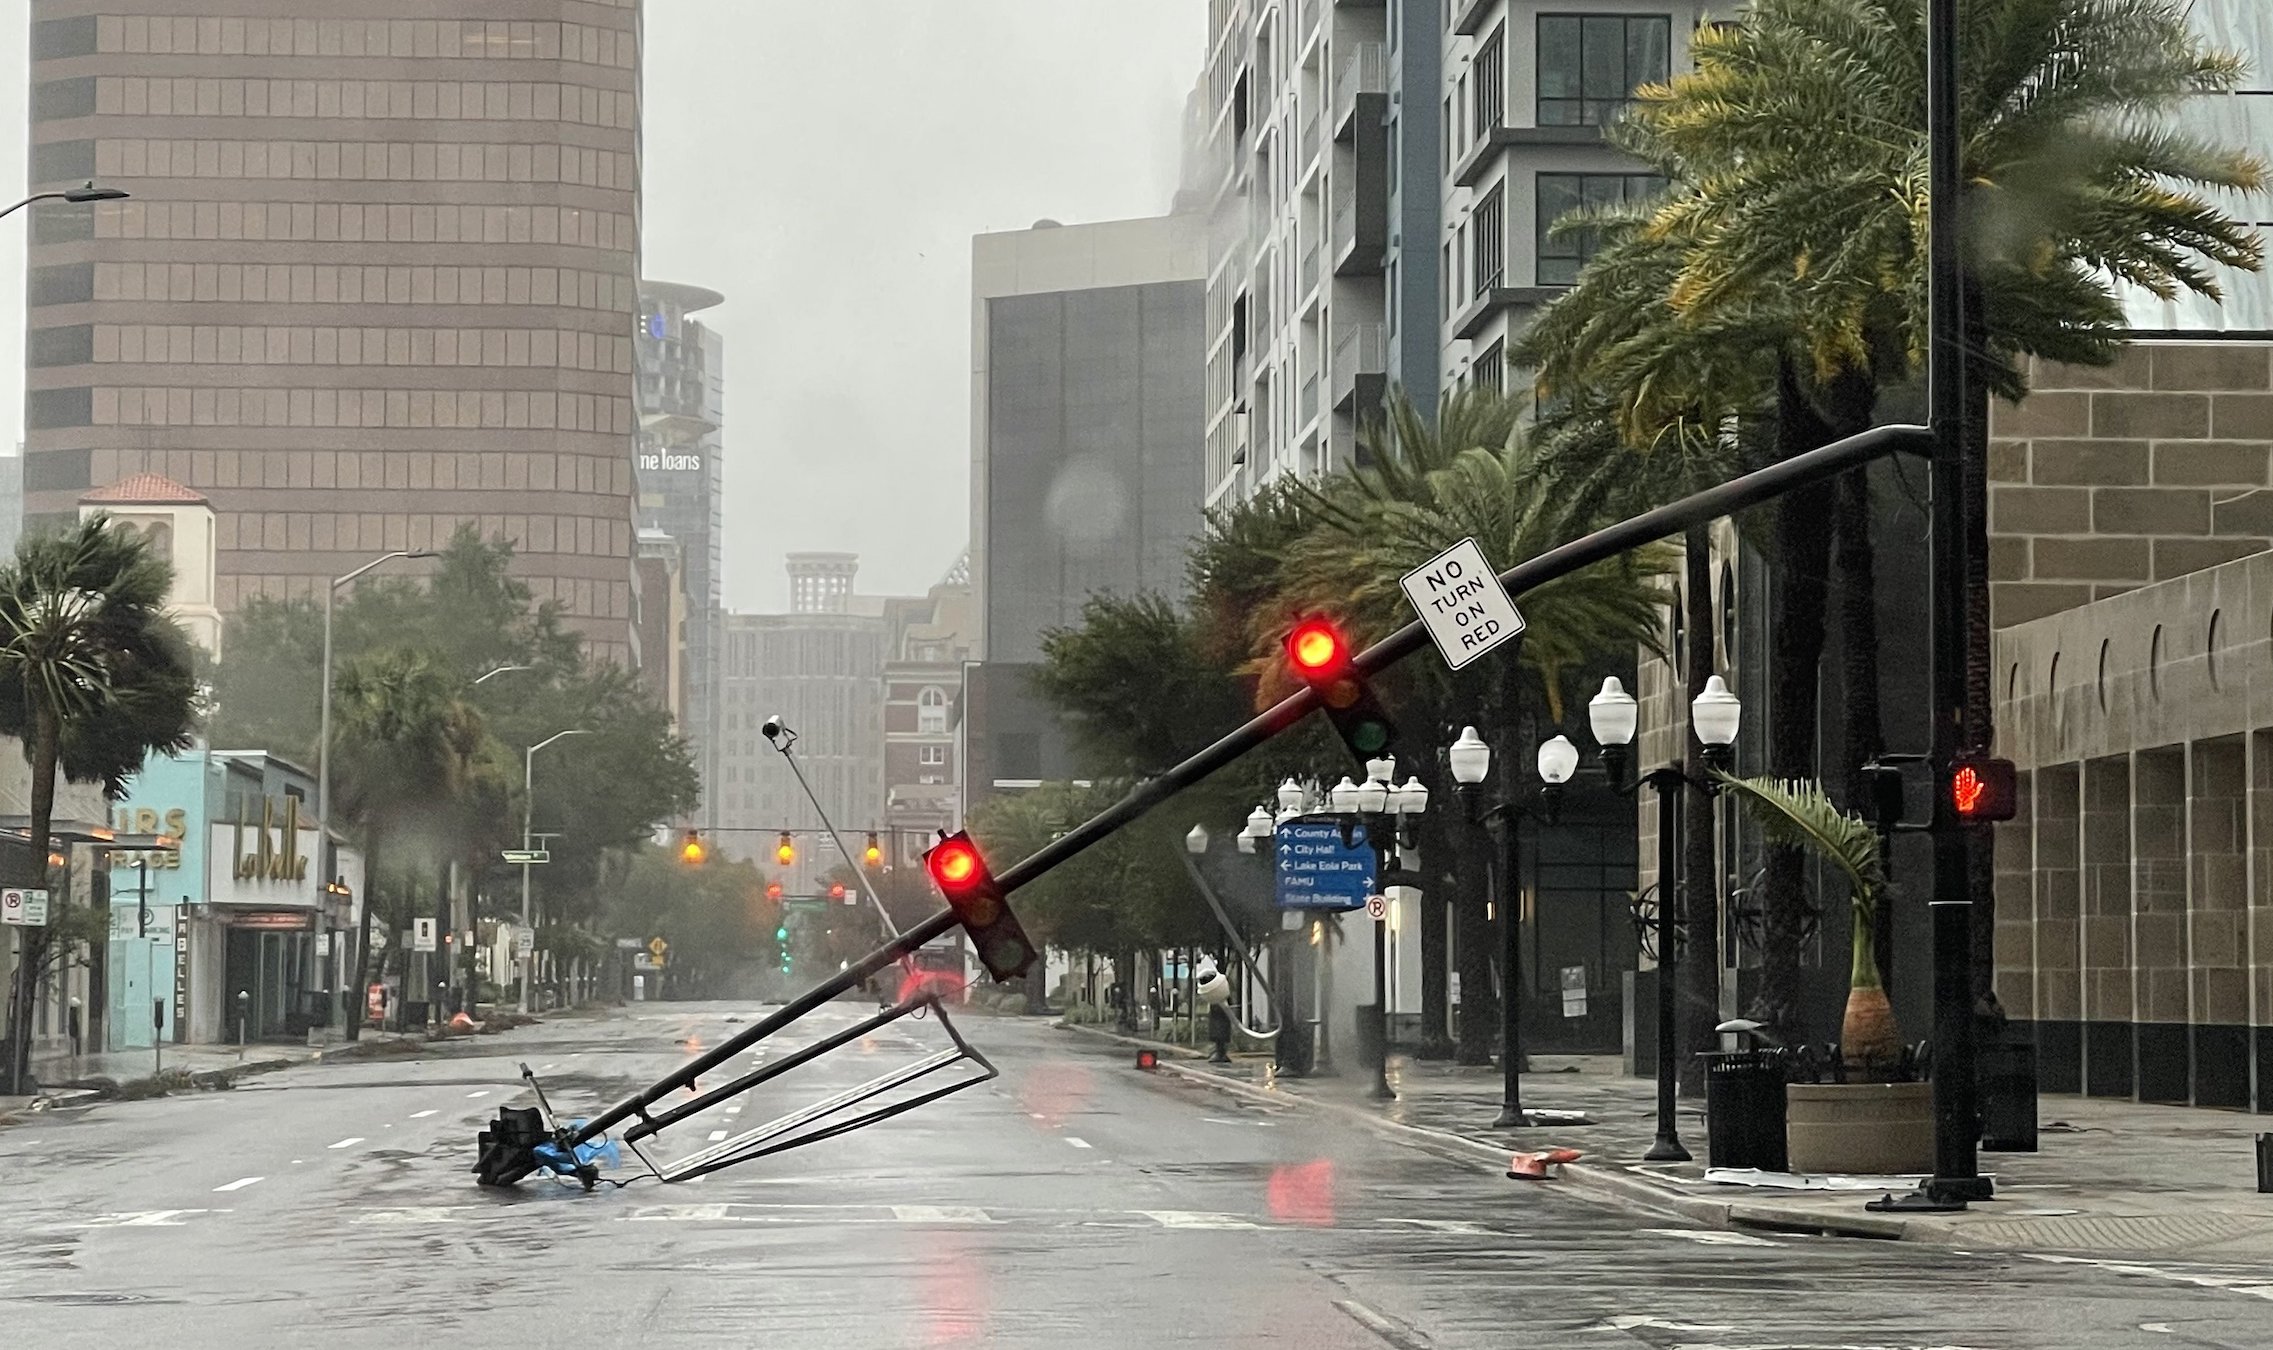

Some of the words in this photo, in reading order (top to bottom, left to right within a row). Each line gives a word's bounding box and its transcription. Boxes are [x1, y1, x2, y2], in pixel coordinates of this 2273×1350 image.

[661, 447, 700, 470] loans
[1426, 561, 1462, 592] NO
[1431, 576, 1484, 614] TURN
[1455, 601, 1485, 626] ON
[1461, 619, 1499, 650] RED
[1294, 828, 1329, 839] County
[1294, 845, 1314, 855] City
[1315, 845, 1335, 854] Hall
[1294, 861, 1317, 870] Lake
[1318, 861, 1340, 870] Eola
[1341, 861, 1363, 870] Park
[1285, 877, 1314, 886] FAMU
[1312, 894, 1352, 905] Building
